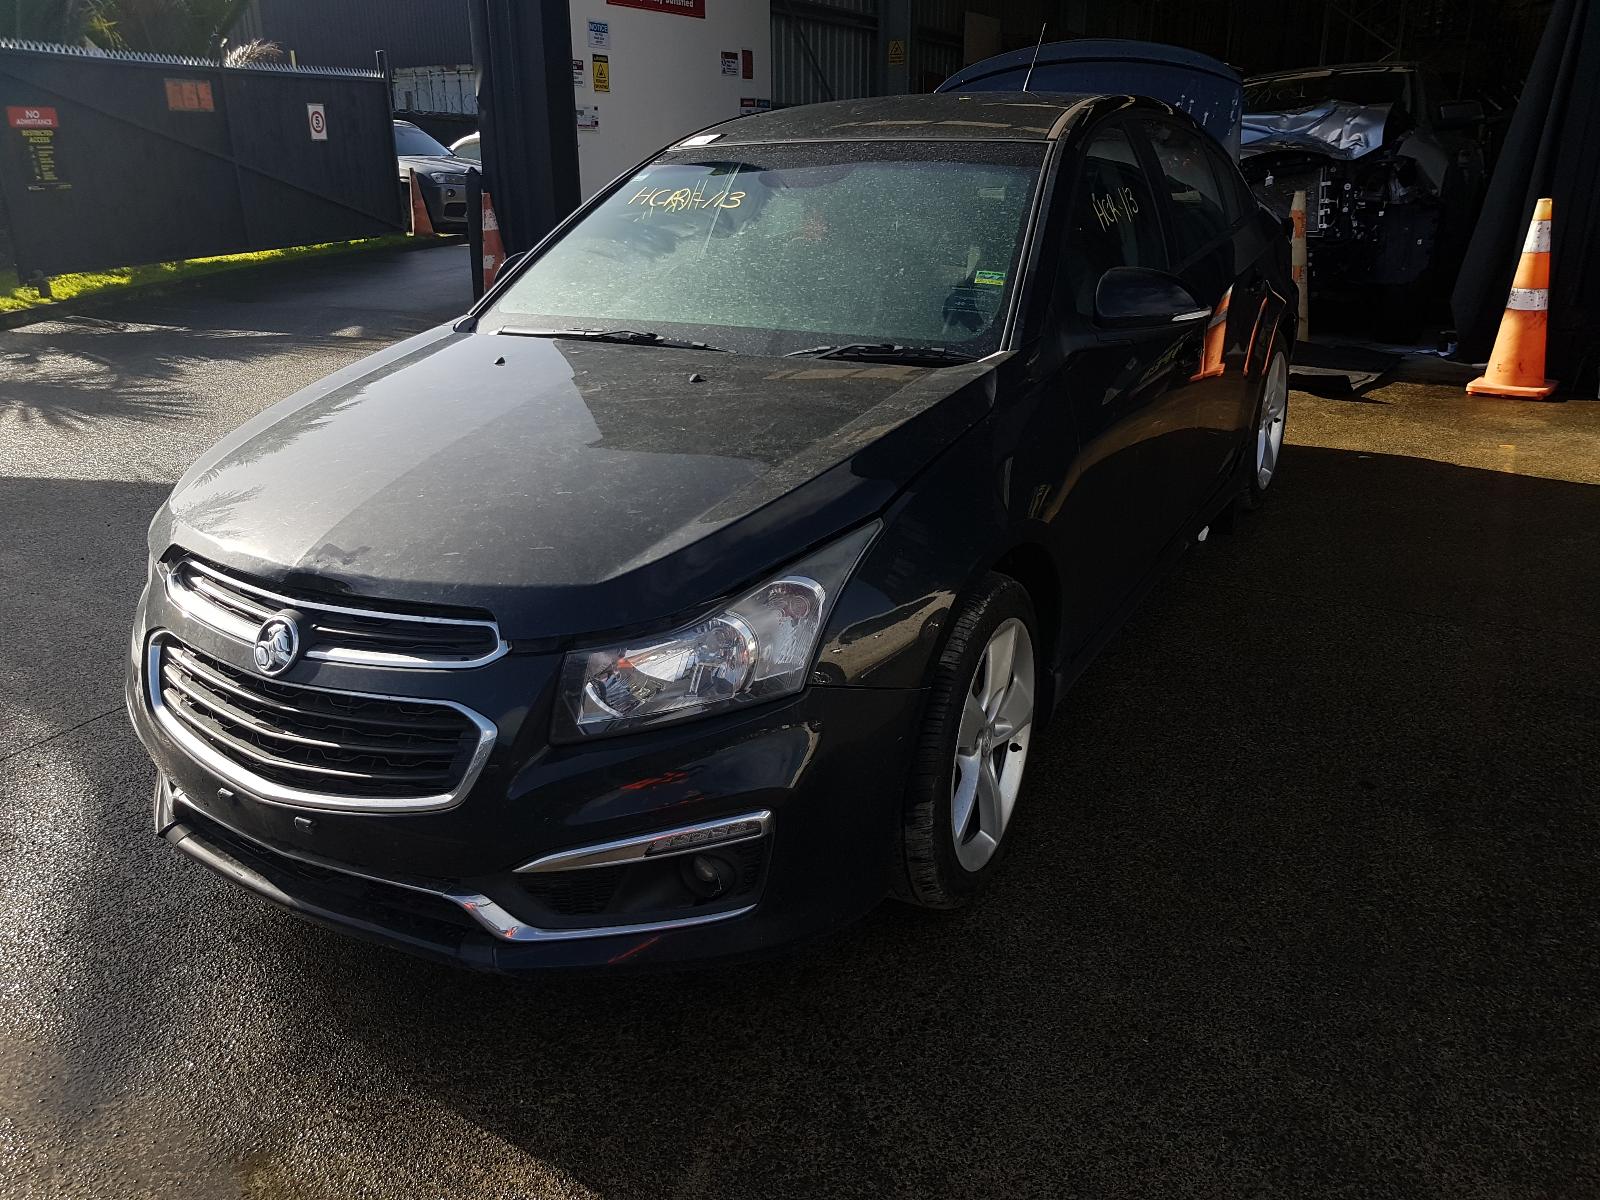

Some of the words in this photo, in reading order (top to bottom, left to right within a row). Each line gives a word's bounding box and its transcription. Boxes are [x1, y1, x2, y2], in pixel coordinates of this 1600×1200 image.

[588, 23, 608, 33] NOTICE
[25, 110, 40, 118] NO
[315, 115, 320, 125] 5
